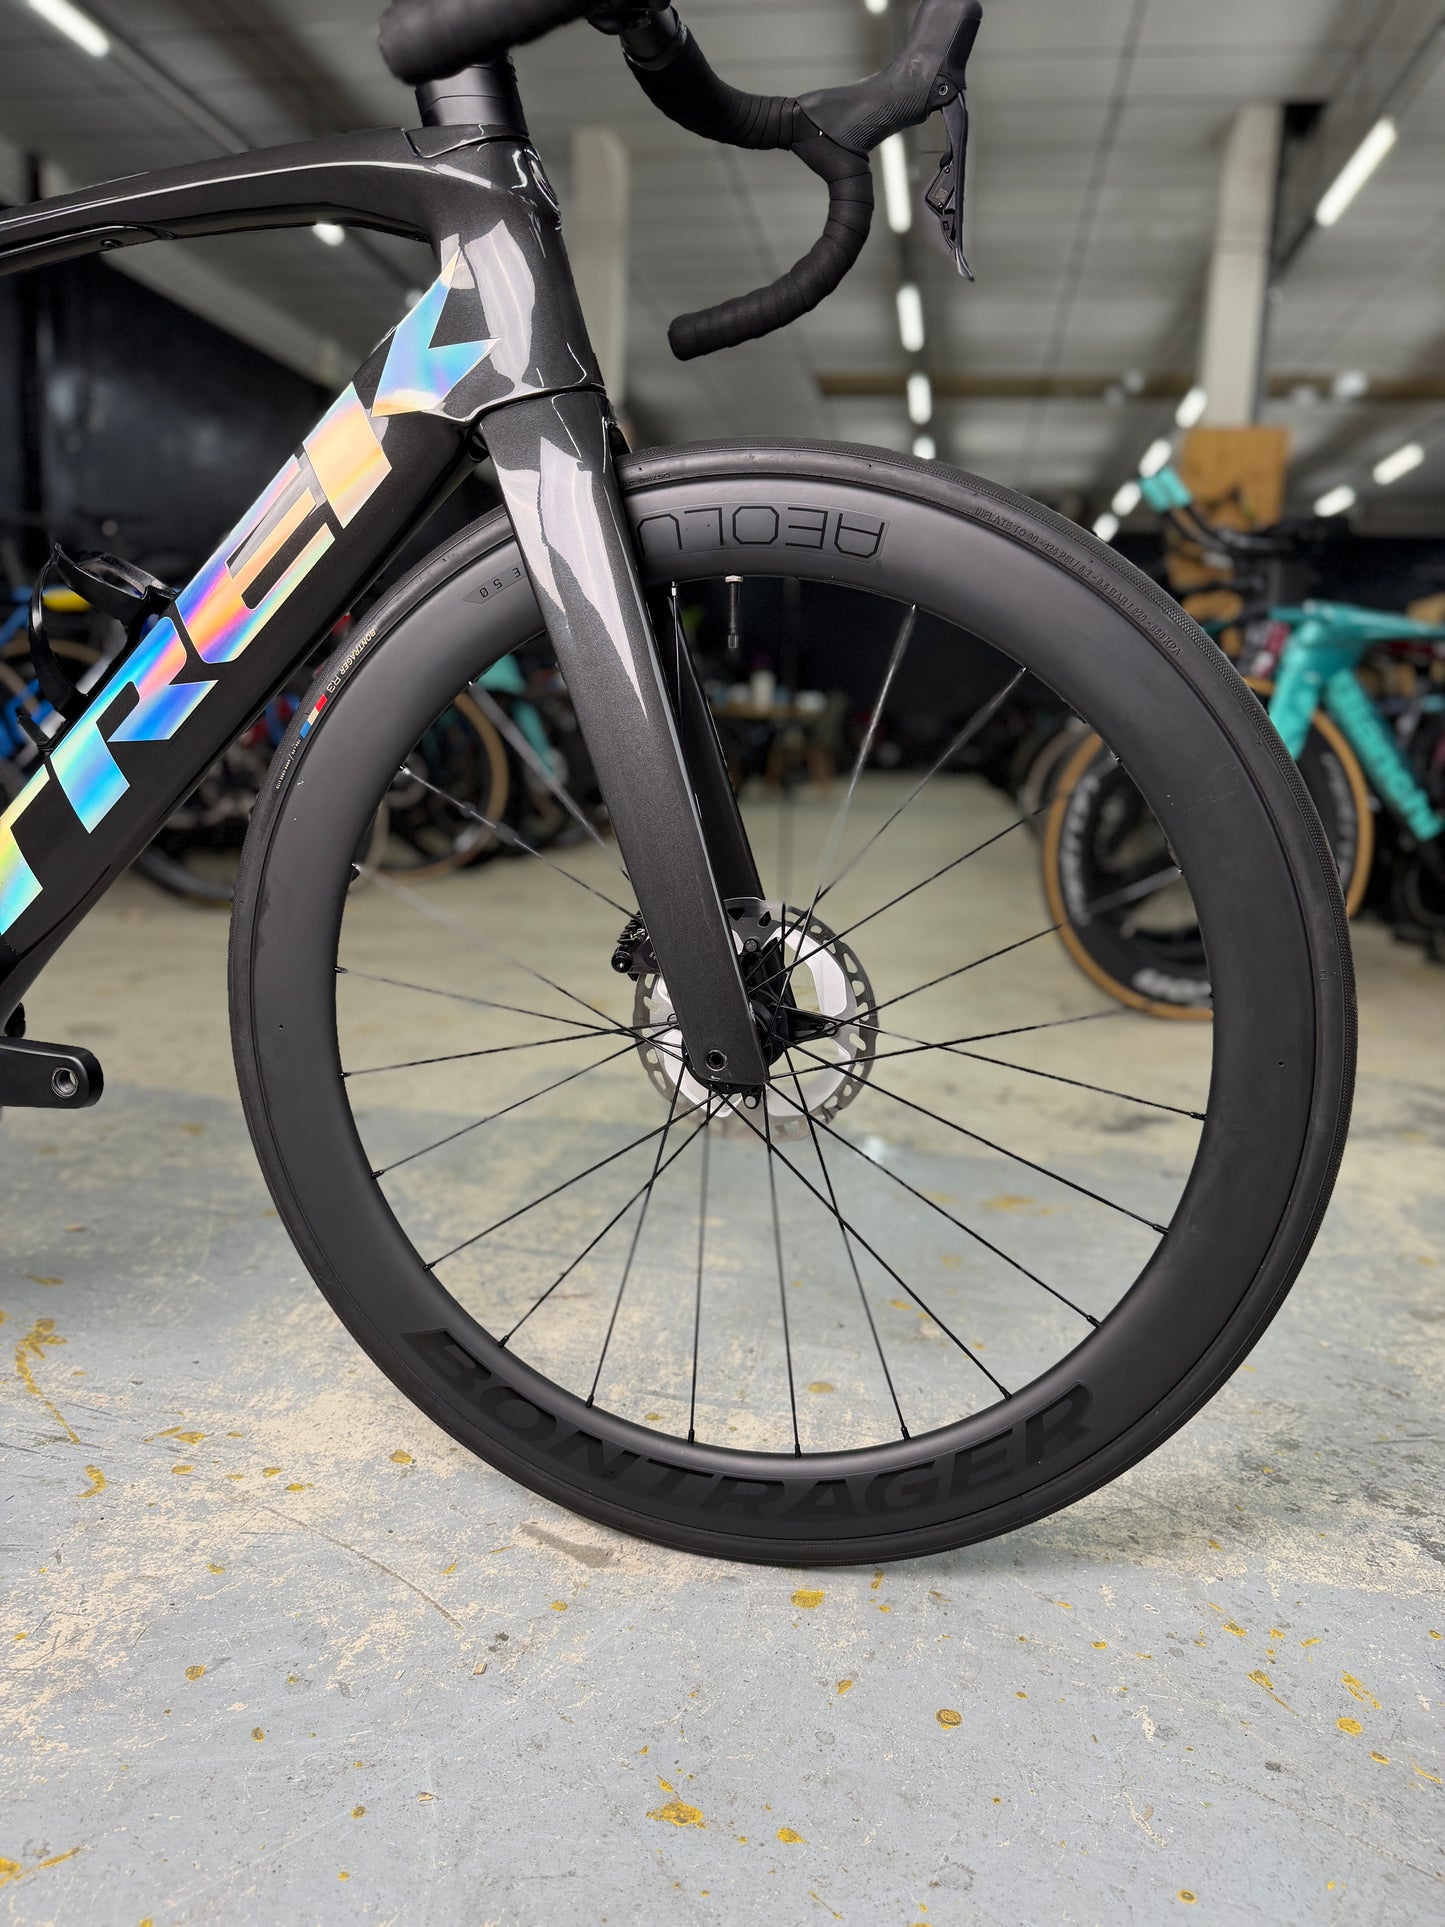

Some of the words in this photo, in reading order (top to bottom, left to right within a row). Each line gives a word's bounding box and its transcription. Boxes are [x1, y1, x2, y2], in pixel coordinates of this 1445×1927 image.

[637, 506, 885, 559] AEOLU
[974, 506, 1013, 529] INFLATE
[1013, 525, 1026, 537] TO
[1109, 587, 1129, 606] BAR
[1163, 636, 1181, 656] KPA
[0, 249, 501, 936] TREK
[326, 675, 341, 693] R3
[339, 628, 377, 674] BONTRAGER
[401, 1328, 1094, 1521] BONTRAGER
